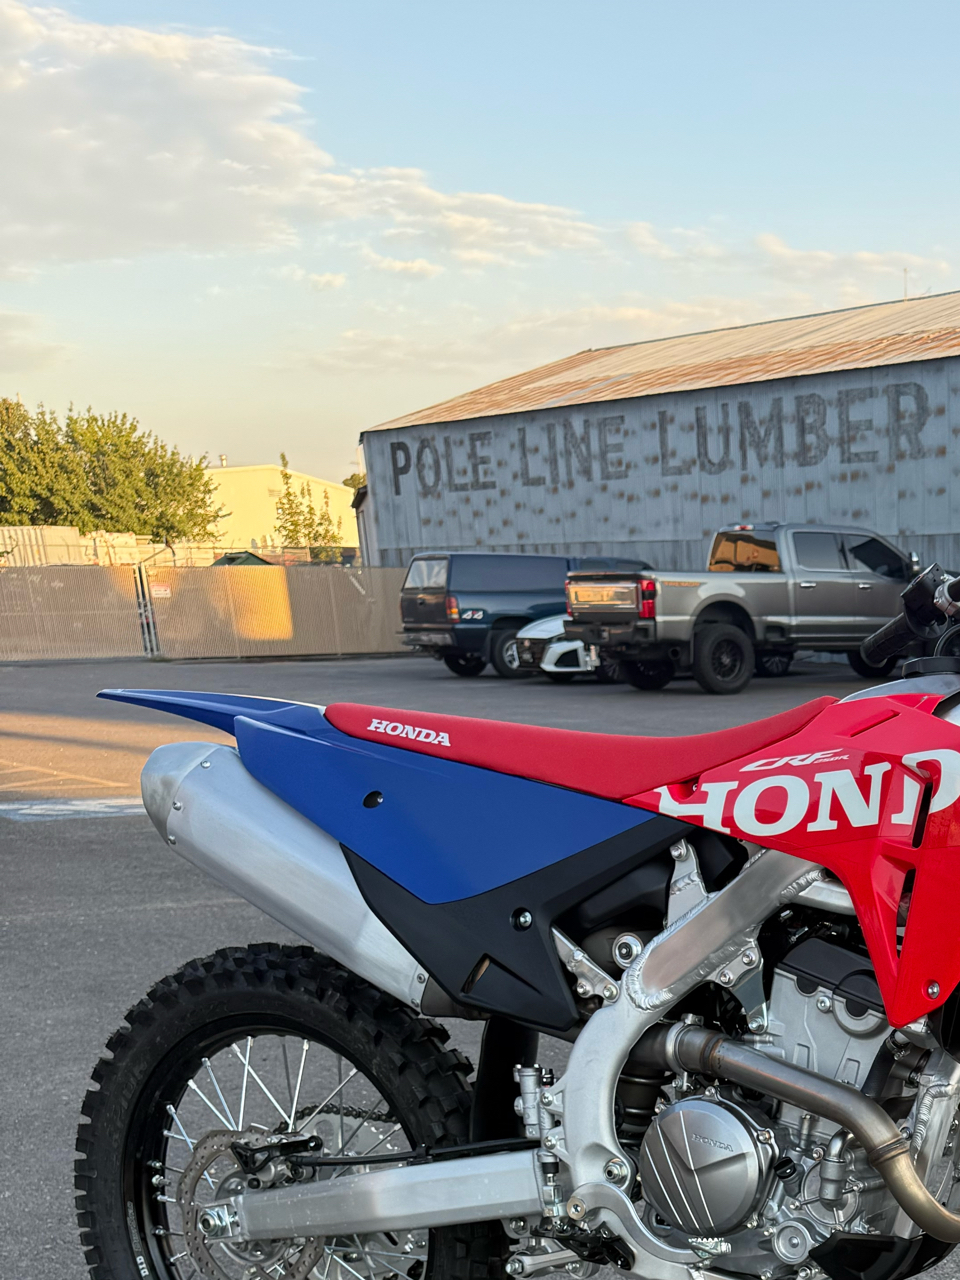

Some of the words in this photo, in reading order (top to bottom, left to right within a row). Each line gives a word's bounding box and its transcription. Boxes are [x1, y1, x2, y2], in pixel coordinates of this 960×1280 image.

[390, 430, 497, 497] POLE
[517, 414, 629, 487] LINE
[657, 380, 930, 477] LUMBER
[367, 718, 451, 747] HONDA
[739, 748, 843, 773] CRF
[691, 1132, 734, 1152] HONDA
